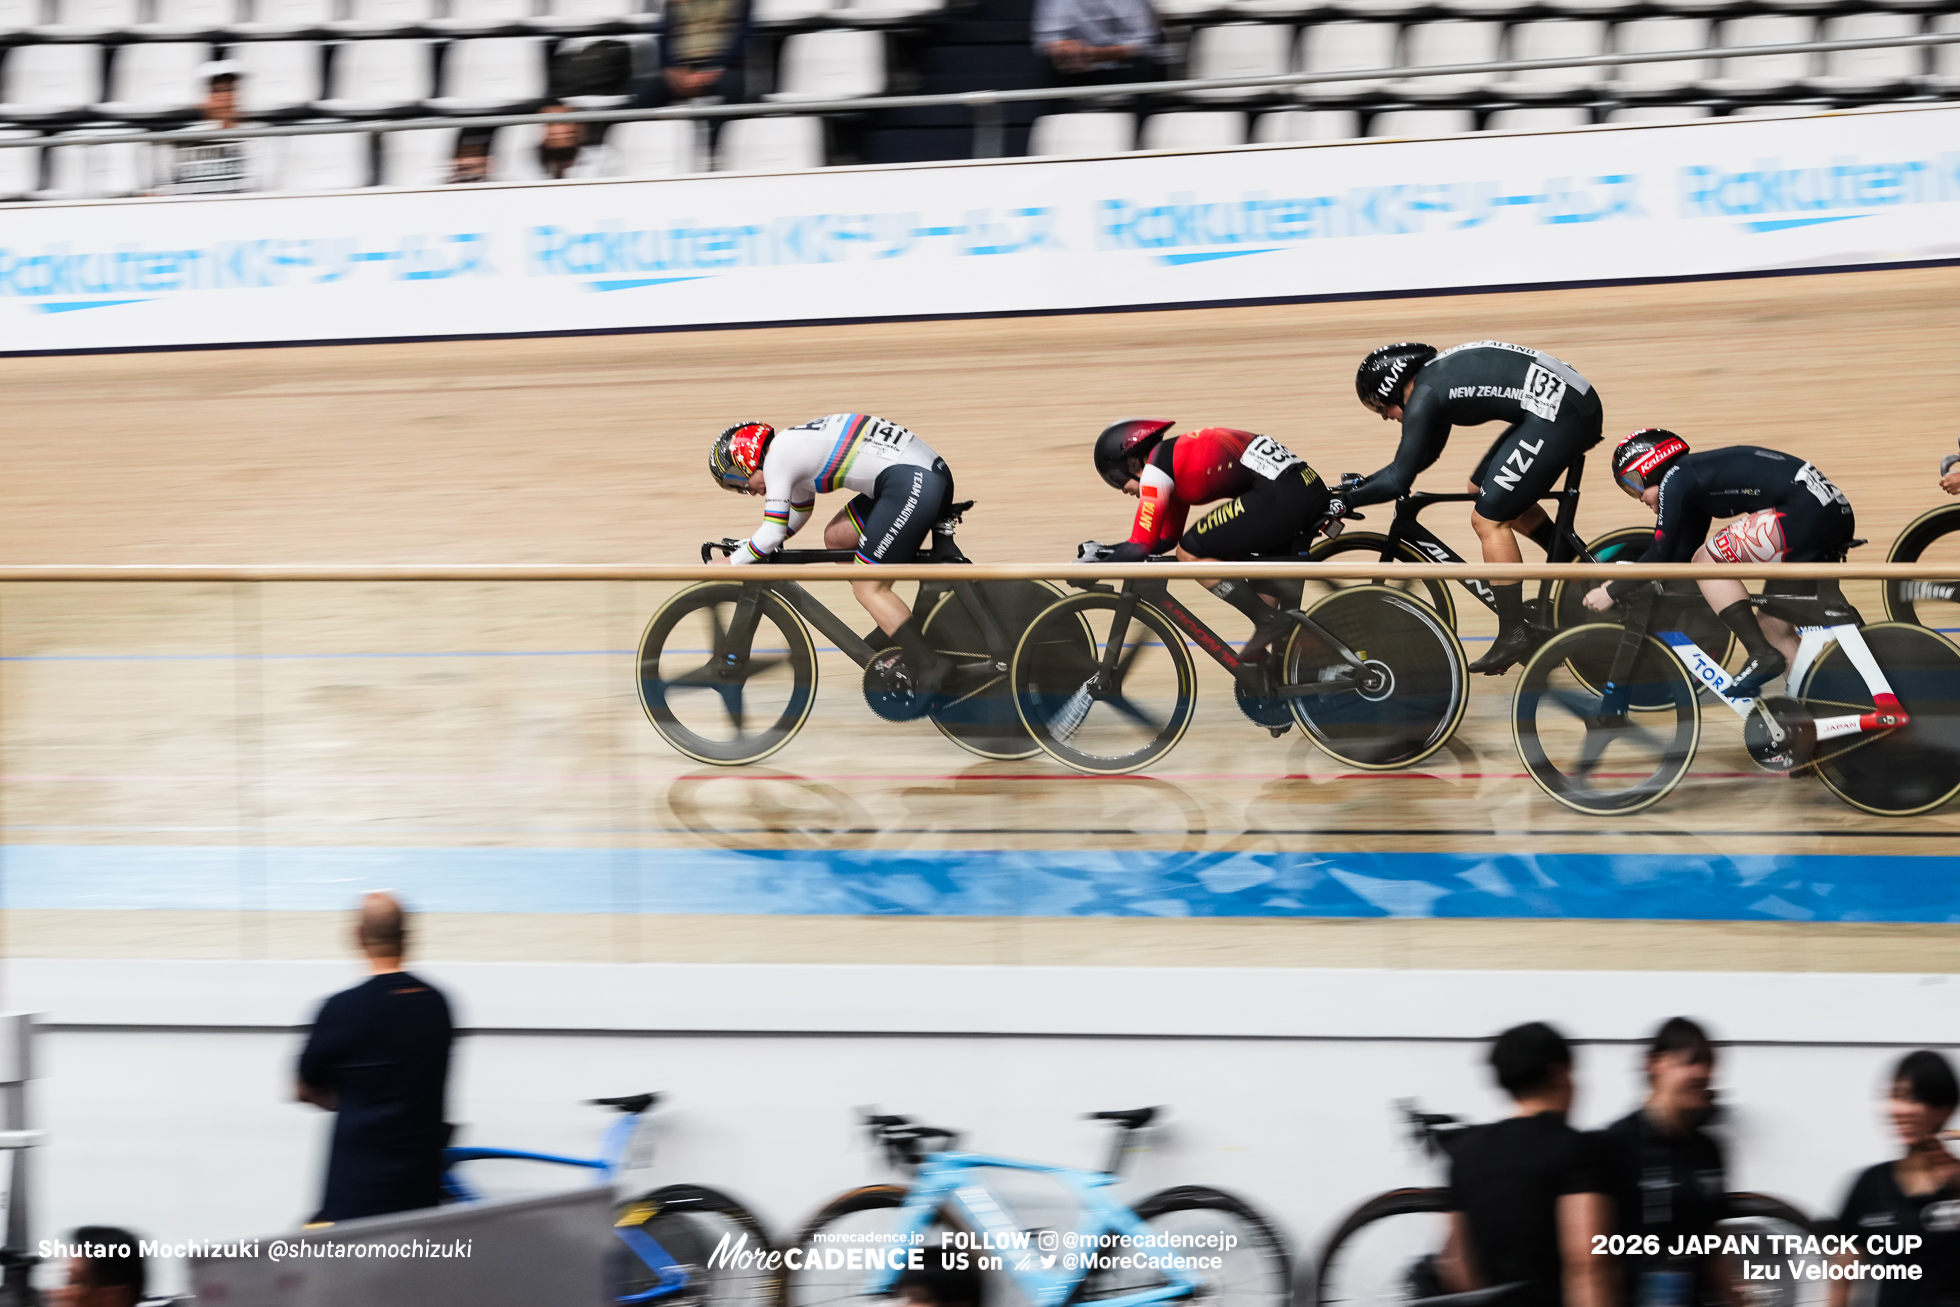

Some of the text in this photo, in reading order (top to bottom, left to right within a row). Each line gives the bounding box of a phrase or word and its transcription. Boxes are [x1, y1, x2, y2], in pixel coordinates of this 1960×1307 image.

[1095, 189, 1343, 251] Rakuten
[525, 217, 767, 277] Rakuten
[1449, 386, 1476, 400] NEW
[1530, 368, 1562, 400] 137
[869, 421, 903, 445] 141
[1493, 438, 1544, 492] NZL
[1618, 443, 1644, 467] JAPAN
[1640, 443, 1683, 474] Kabuto
[911, 471, 923, 498] TEAM
[893, 496, 918, 530] RAKUTEN
[1138, 501, 1156, 532] ANTA
[1197, 496, 1246, 535] CHINA
[1161, 601, 1222, 653] ARGON
[1824, 721, 1857, 733] JAPAN
